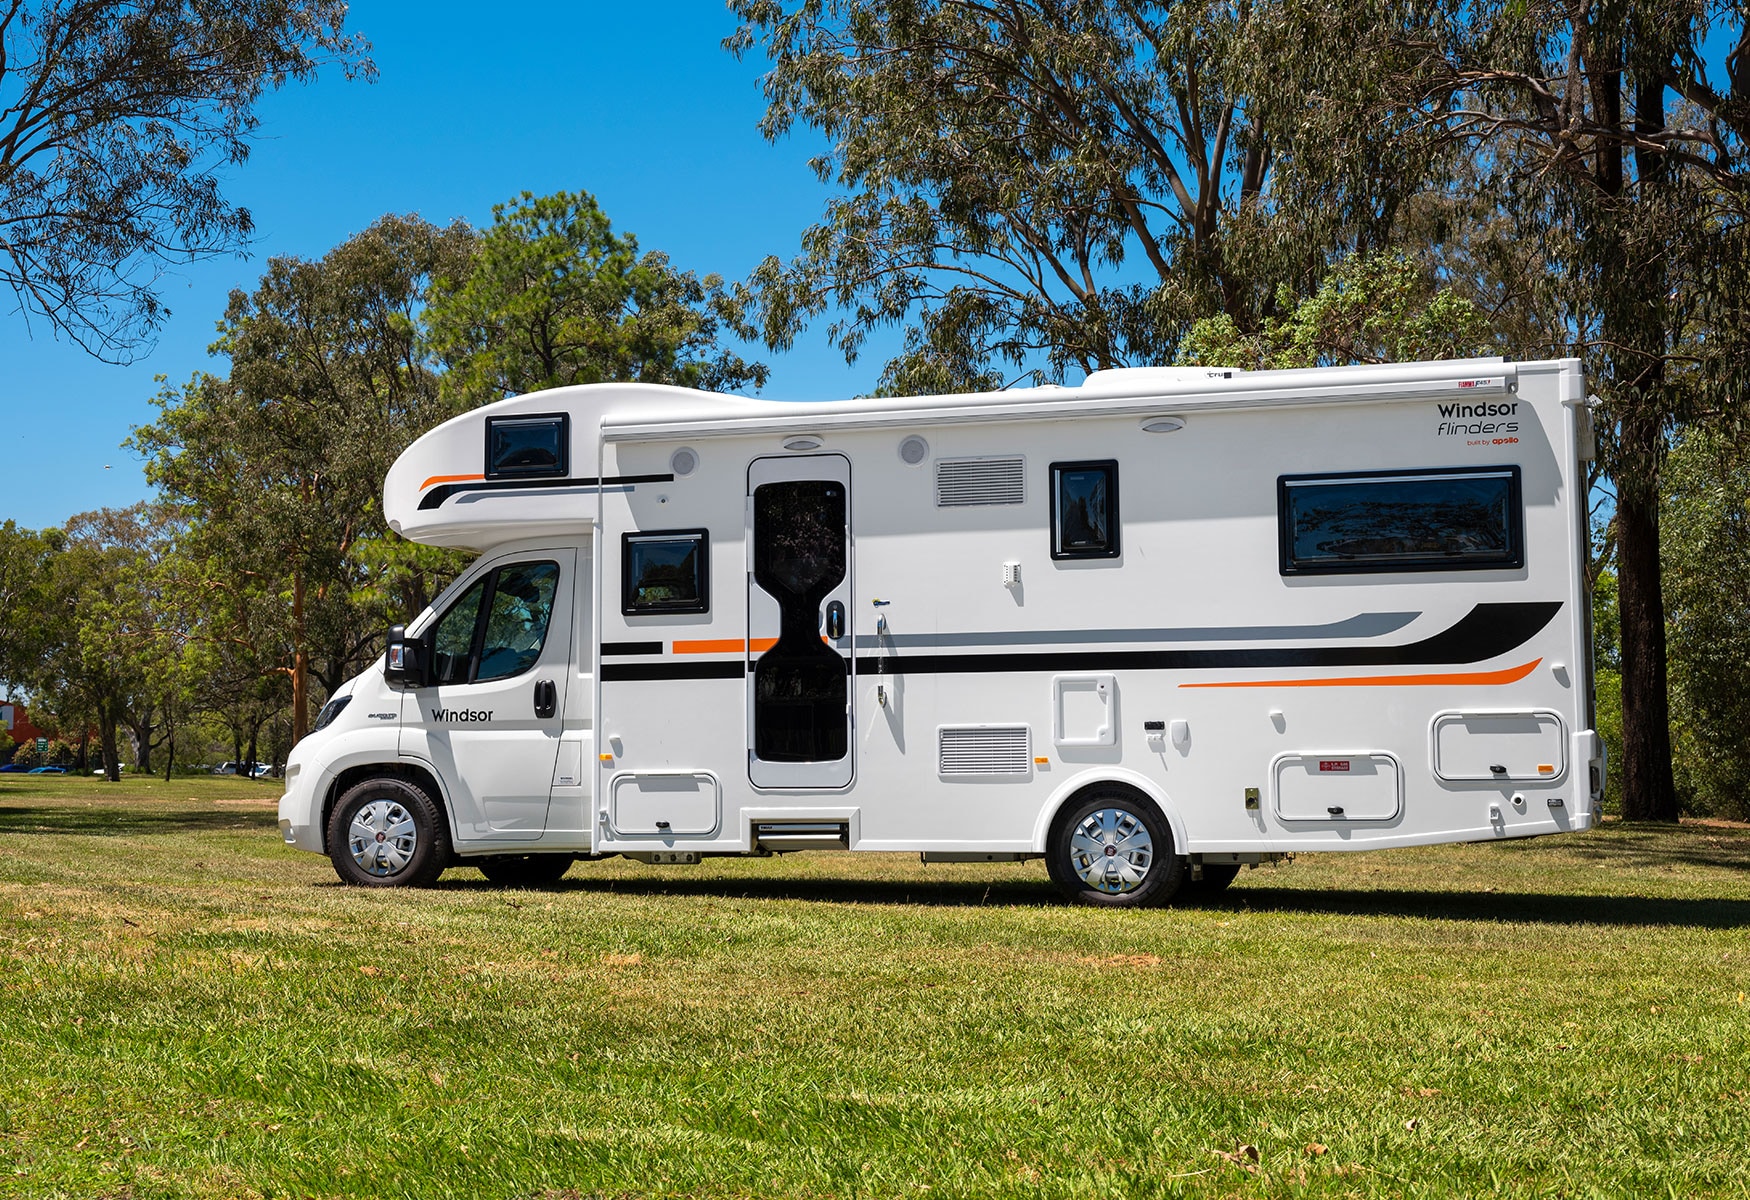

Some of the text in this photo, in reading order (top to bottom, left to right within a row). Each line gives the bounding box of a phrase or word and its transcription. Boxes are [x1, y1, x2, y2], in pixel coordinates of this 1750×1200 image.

[1437, 401, 1519, 419] Windsor
[1438, 420, 1519, 436] flinders
[1481, 439, 1491, 447] by
[1491, 437, 1519, 446] apollo
[431, 708, 494, 722] Windsor
